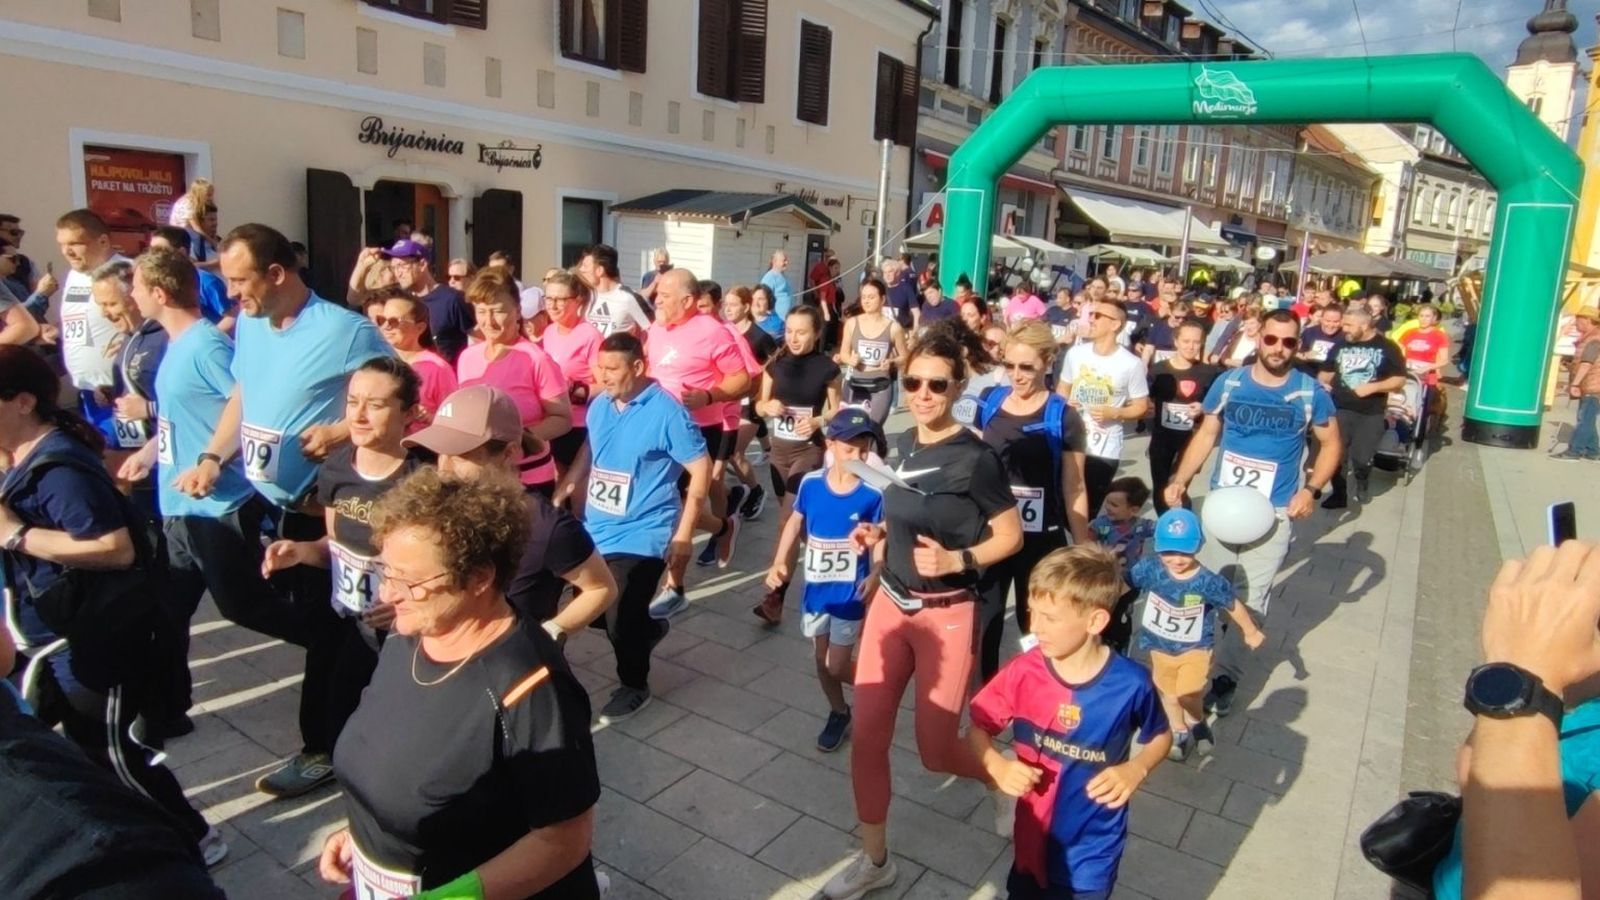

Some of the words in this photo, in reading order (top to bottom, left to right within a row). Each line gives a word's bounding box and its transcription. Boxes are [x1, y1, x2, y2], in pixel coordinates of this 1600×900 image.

[91, 179, 120, 191] PAKET
[122, 182, 135, 192] NA
[137, 182, 173, 195] TRŽIŠTU
[65, 320, 84, 339] 293
[864, 347, 881, 360] 50
[117, 419, 139, 439] 80
[1232, 466, 1261, 490] 92
[807, 548, 850, 573] 155
[1151, 606, 1198, 635] 157
